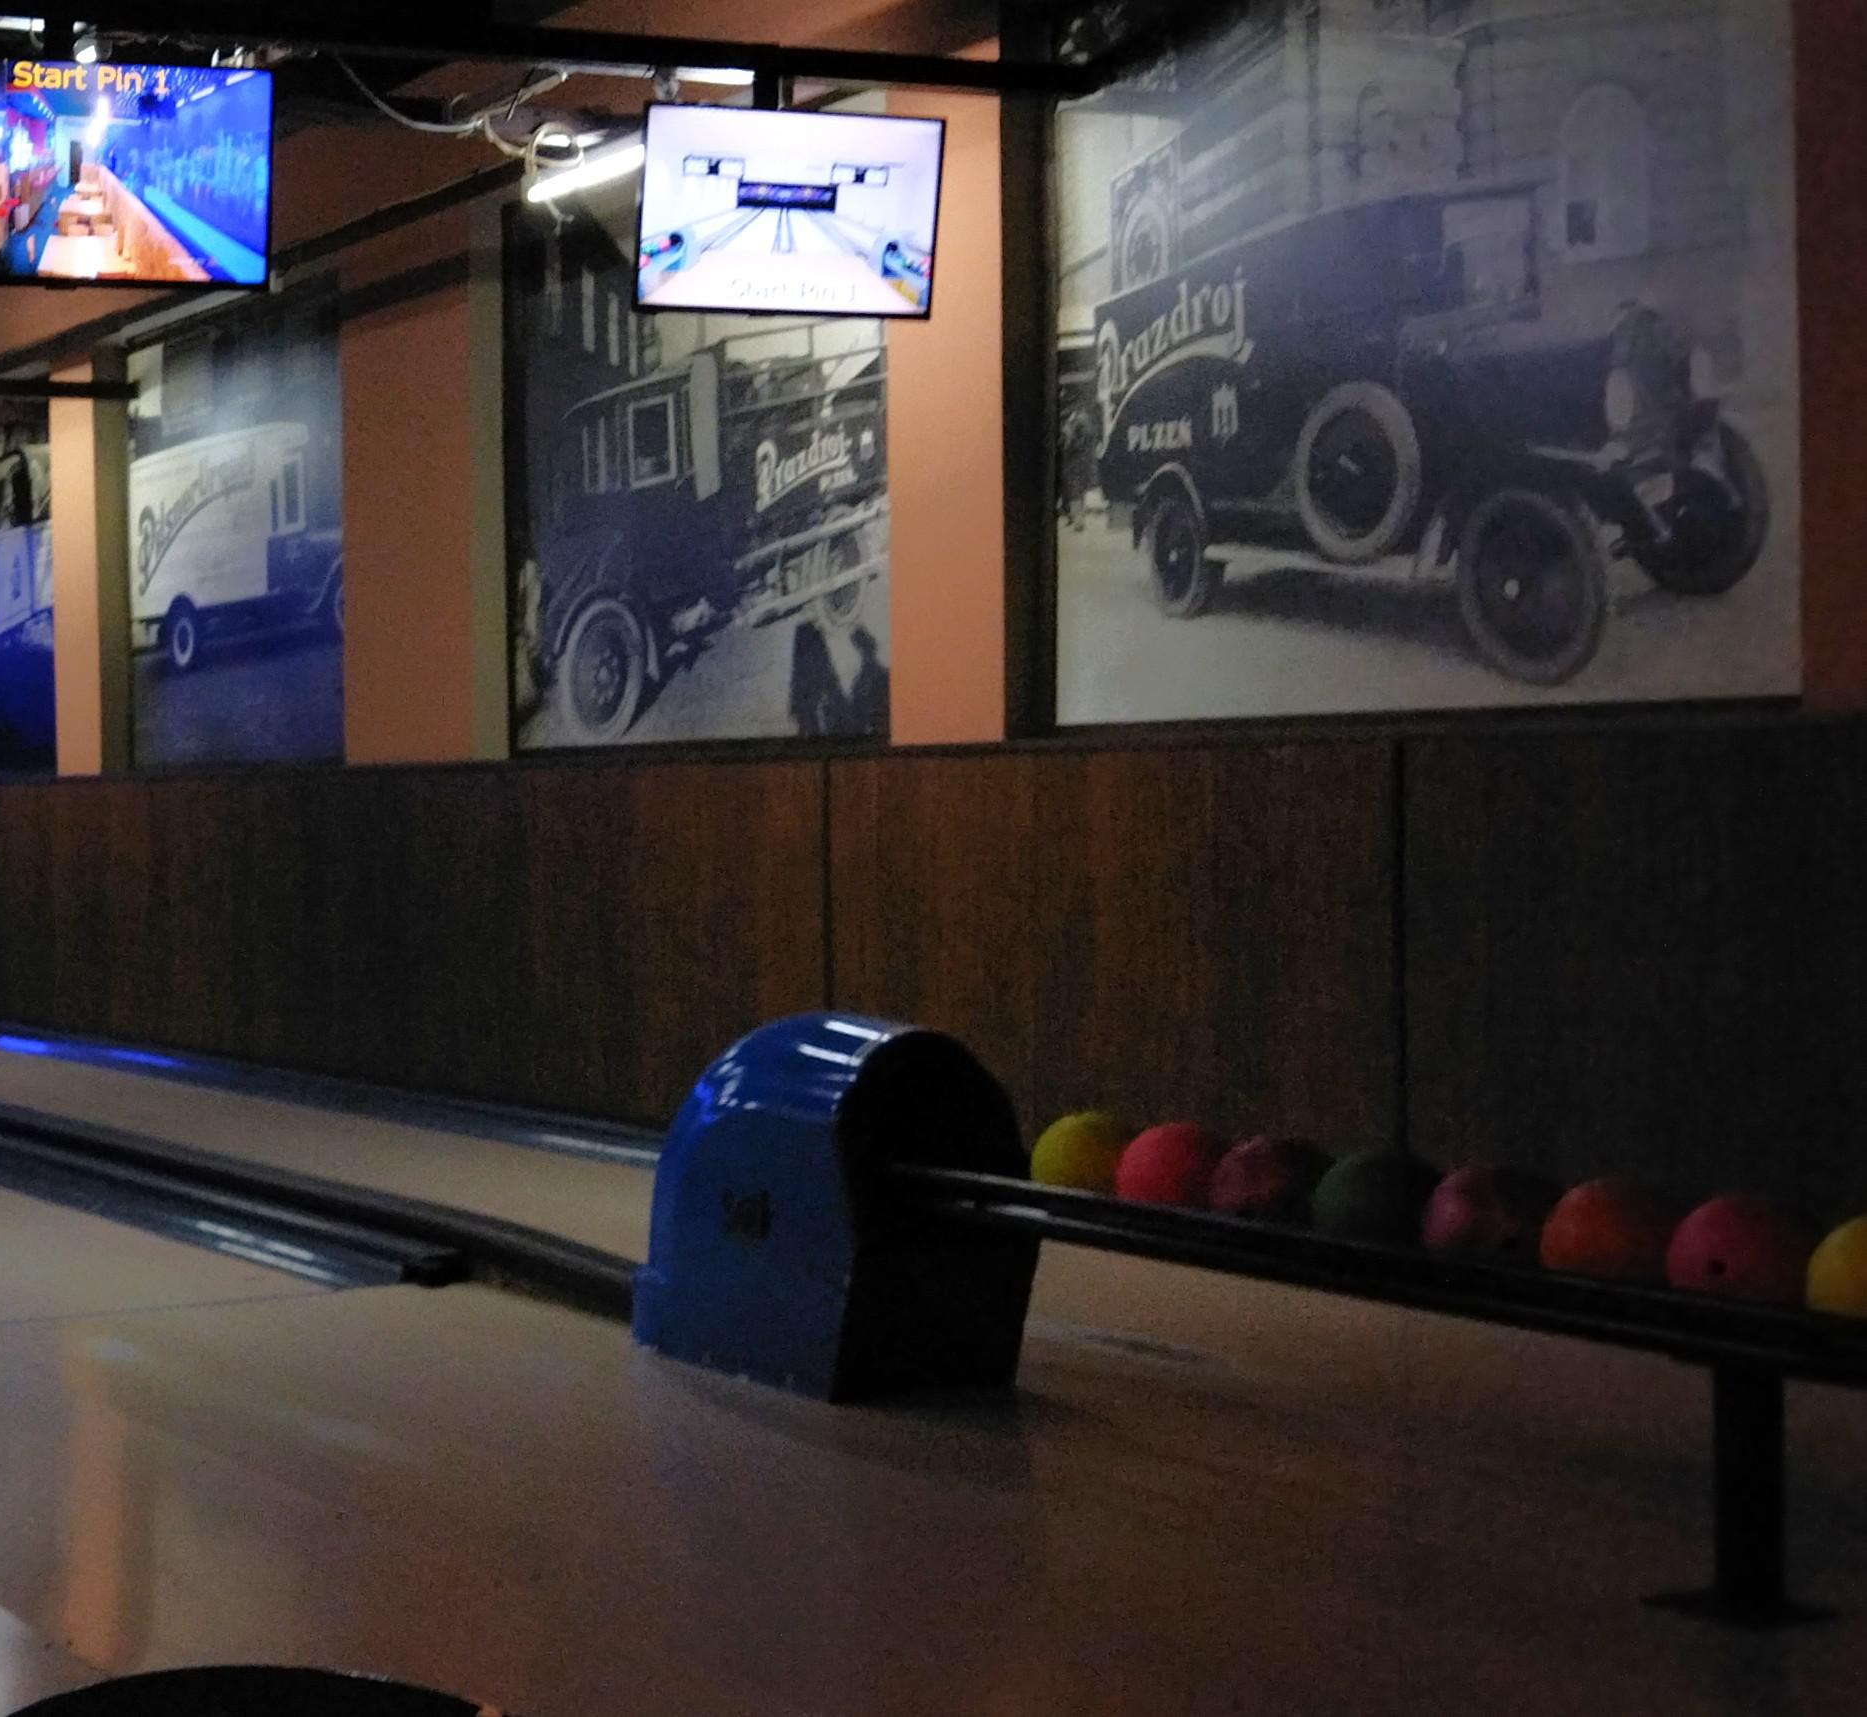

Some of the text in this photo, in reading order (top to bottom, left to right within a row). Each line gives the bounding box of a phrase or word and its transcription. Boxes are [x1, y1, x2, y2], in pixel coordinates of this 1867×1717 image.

[12, 61, 170, 95] Start Pin 1
[730, 279, 787, 298] Start
[800, 281, 836, 302] Pin
[1097, 263, 1255, 459] Prazdroj
[755, 422, 854, 513] Prazdroj
